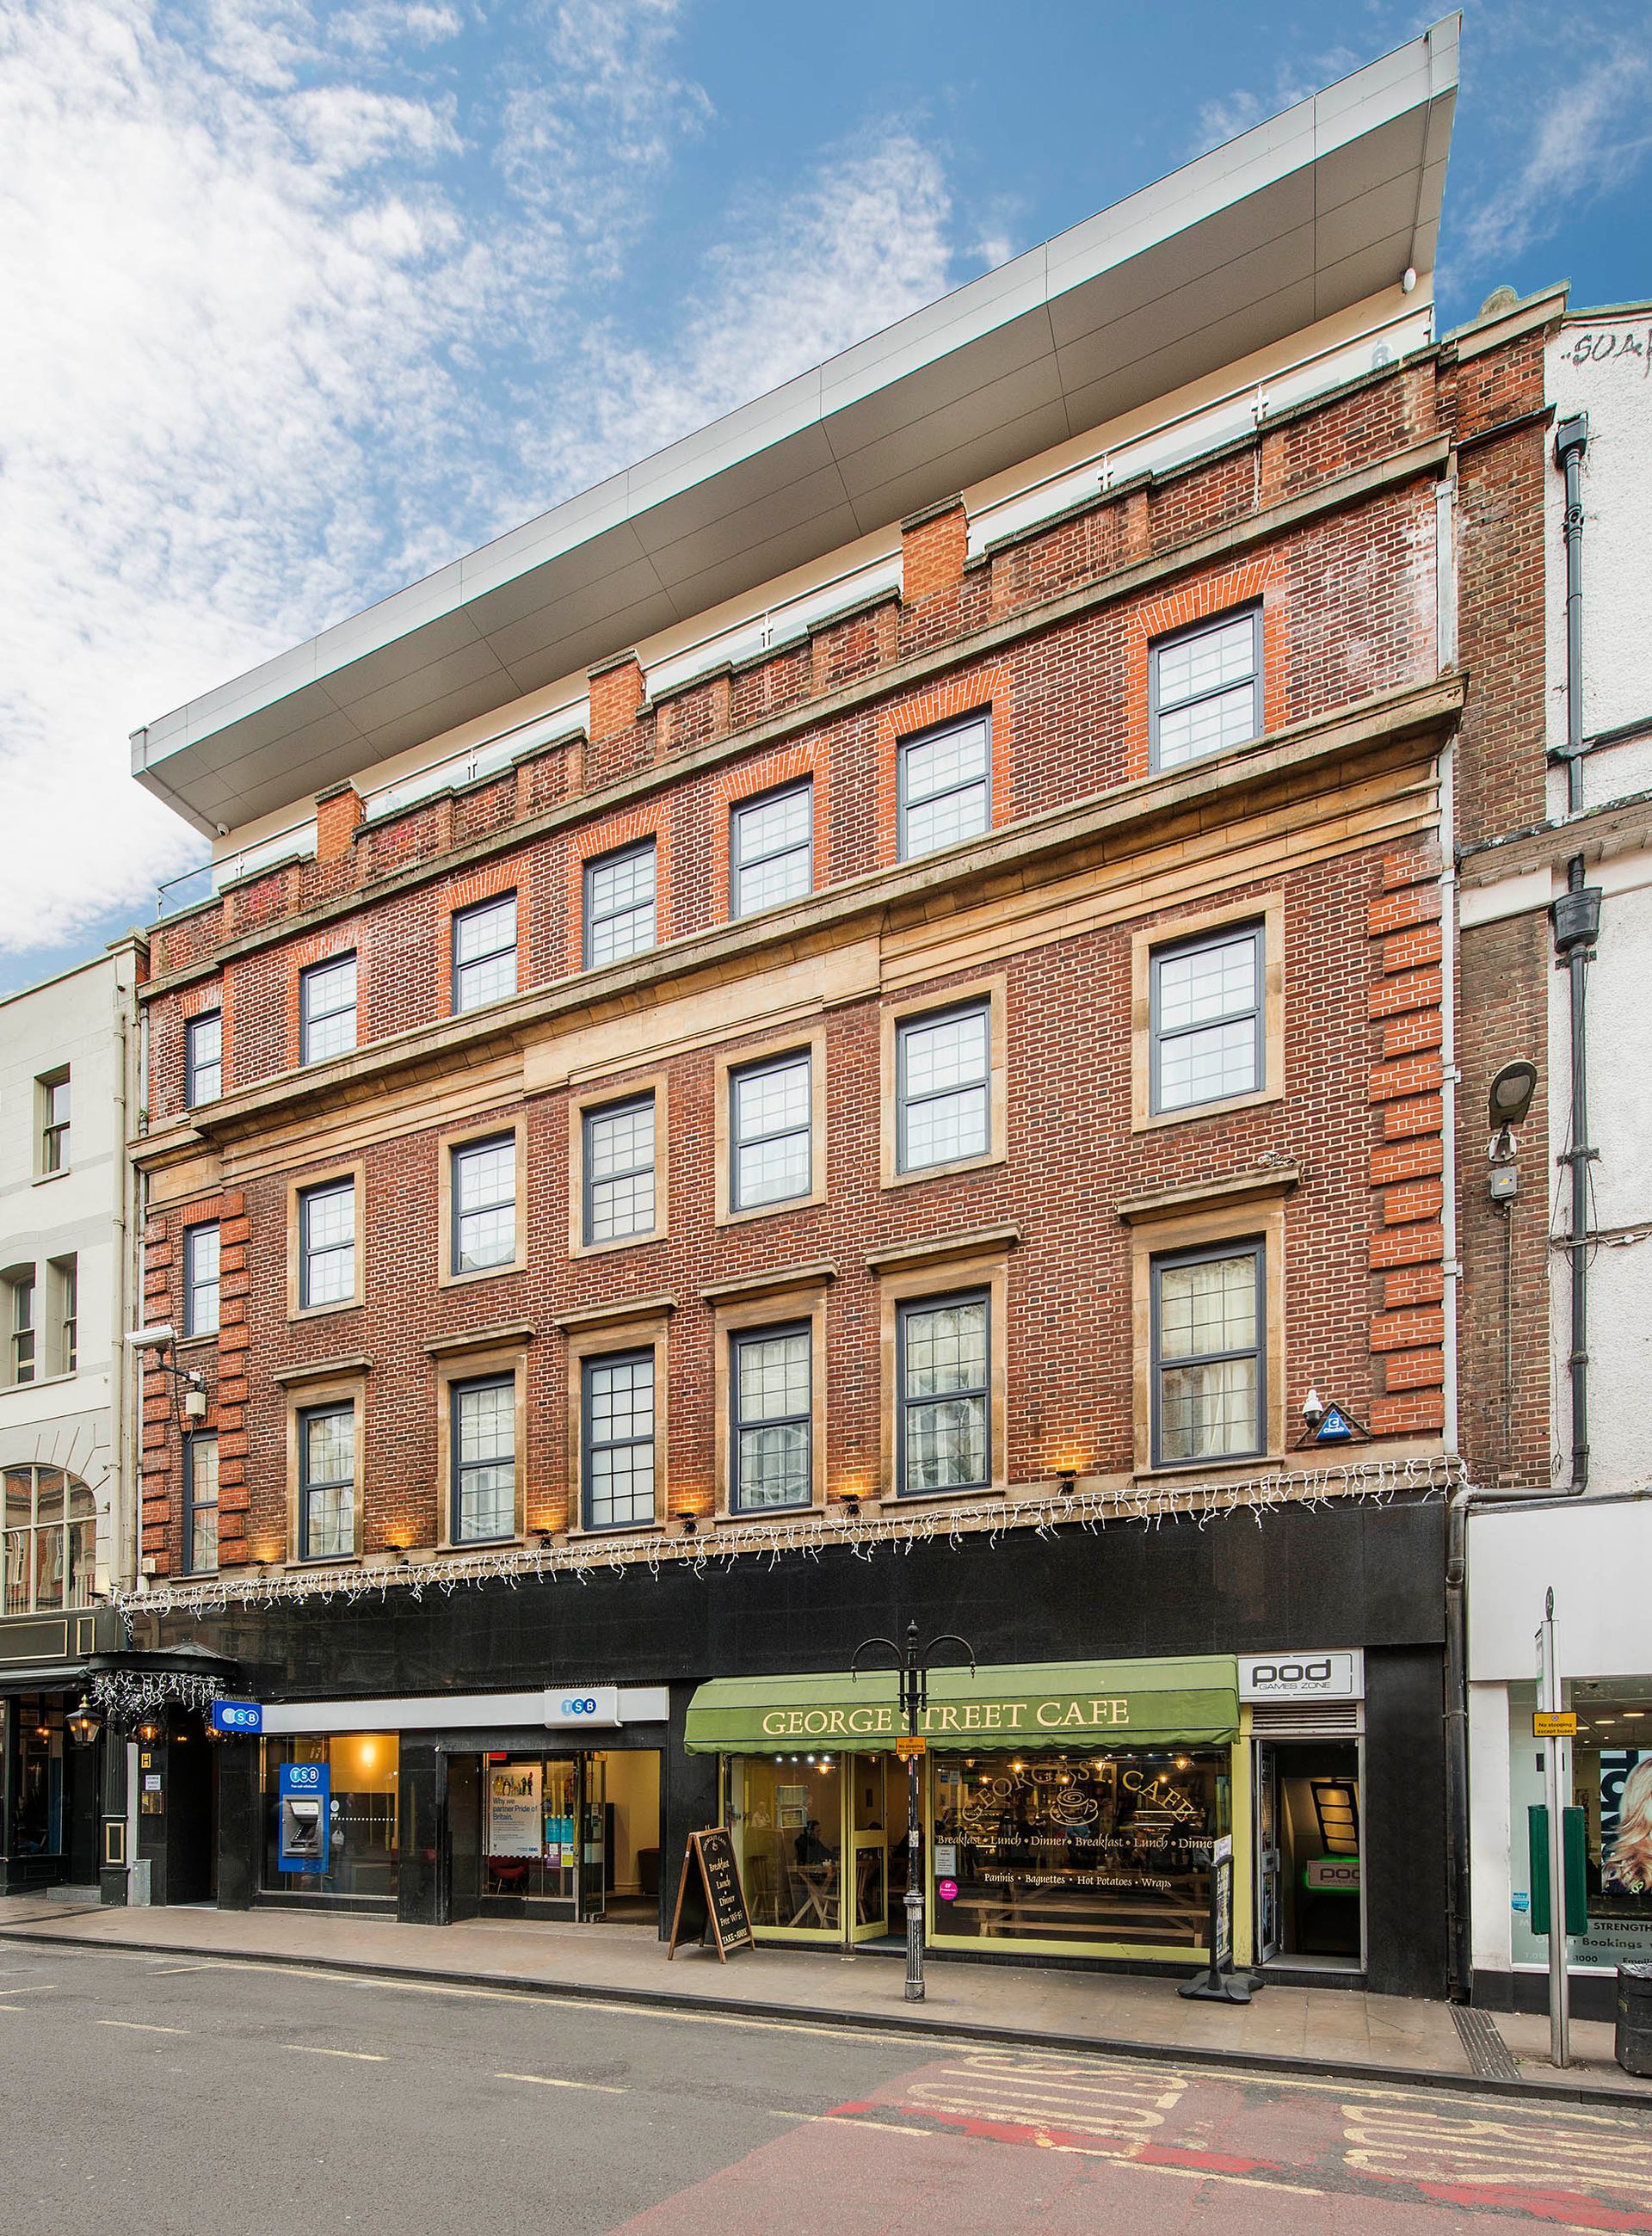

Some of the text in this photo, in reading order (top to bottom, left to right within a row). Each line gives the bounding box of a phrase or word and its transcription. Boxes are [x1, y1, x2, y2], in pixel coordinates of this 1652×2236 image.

[1252, 1659, 1332, 1687] pod
[1259, 1682, 1298, 1691] GAMES
[762, 1708, 892, 1735] GEORGE
[1036, 1699, 1130, 1728] CAFE
[142, 1754, 150, 1767] H
[962, 1764, 1071, 1821] GEORGE
[1121, 1770, 1194, 1822] CAFE
[936, 1831, 982, 1846] Breakfast
[990, 1832, 1021, 1846] Lunch
[1031, 1835, 1068, 1846] Dinner
[1076, 1833, 1124, 1850] Breakfast
[1133, 1834, 1168, 1851] Lunch
[1178, 1837, 1215, 1849] Dinne
[708, 1857, 730, 1873] Breakfast
[715, 1874, 731, 1889] Lunch
[983, 1873, 1172, 1890] Paninis Baguettes Hot Potatoes Wraps
[718, 1894, 736, 1907] Dinner
[720, 1916, 730, 1927] Free
[1582, 1937, 1643, 1950] Bookings
